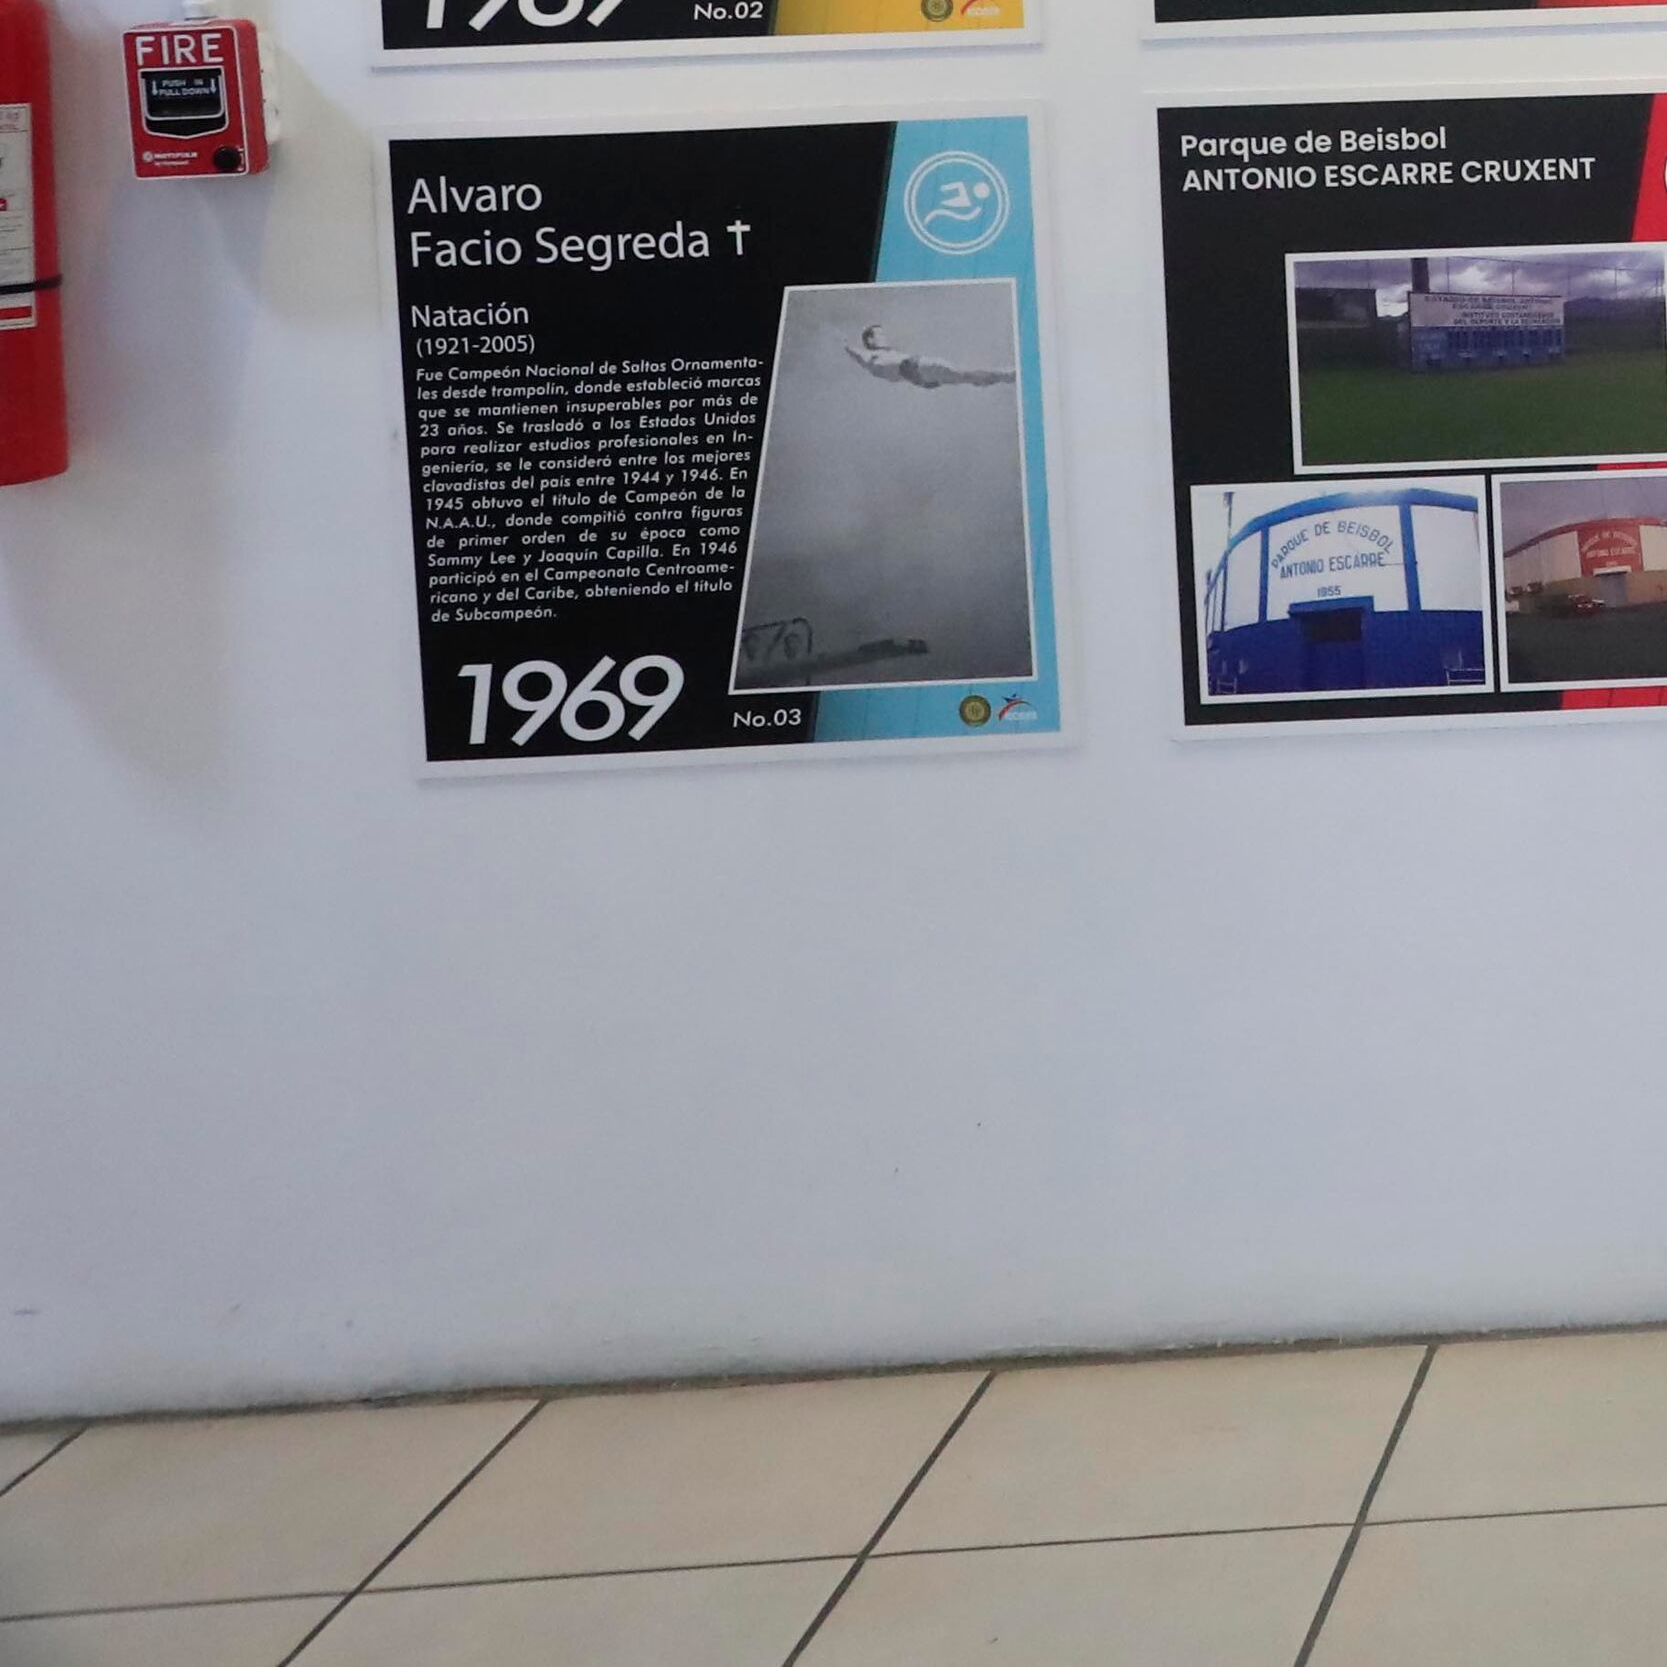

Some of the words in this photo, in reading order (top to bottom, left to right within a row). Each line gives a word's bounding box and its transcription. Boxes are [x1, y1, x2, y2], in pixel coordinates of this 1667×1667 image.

[694, 2, 763, 20] No.02
[135, 33, 224, 66] FIRE
[1182, 136, 1287, 162] Parque
[1295, 130, 1332, 154] de
[1340, 126, 1446, 152] Beisbol
[1183, 166, 1317, 192] ANTONIO
[1325, 162, 1453, 187] ESCARRE
[1462, 158, 1596, 183] CRUXENT
[408, 176, 542, 214] Alvaro
[411, 230, 522, 267] Facio
[536, 221, 709, 271] Segreda
[412, 302, 528, 328] Natación
[417, 334, 535, 358] (1921-2005)
[432, 609, 450, 622] de
[456, 606, 556, 622] Subcampeón.
[458, 655, 684, 746] 1969
[734, 709, 801, 727] No.03
